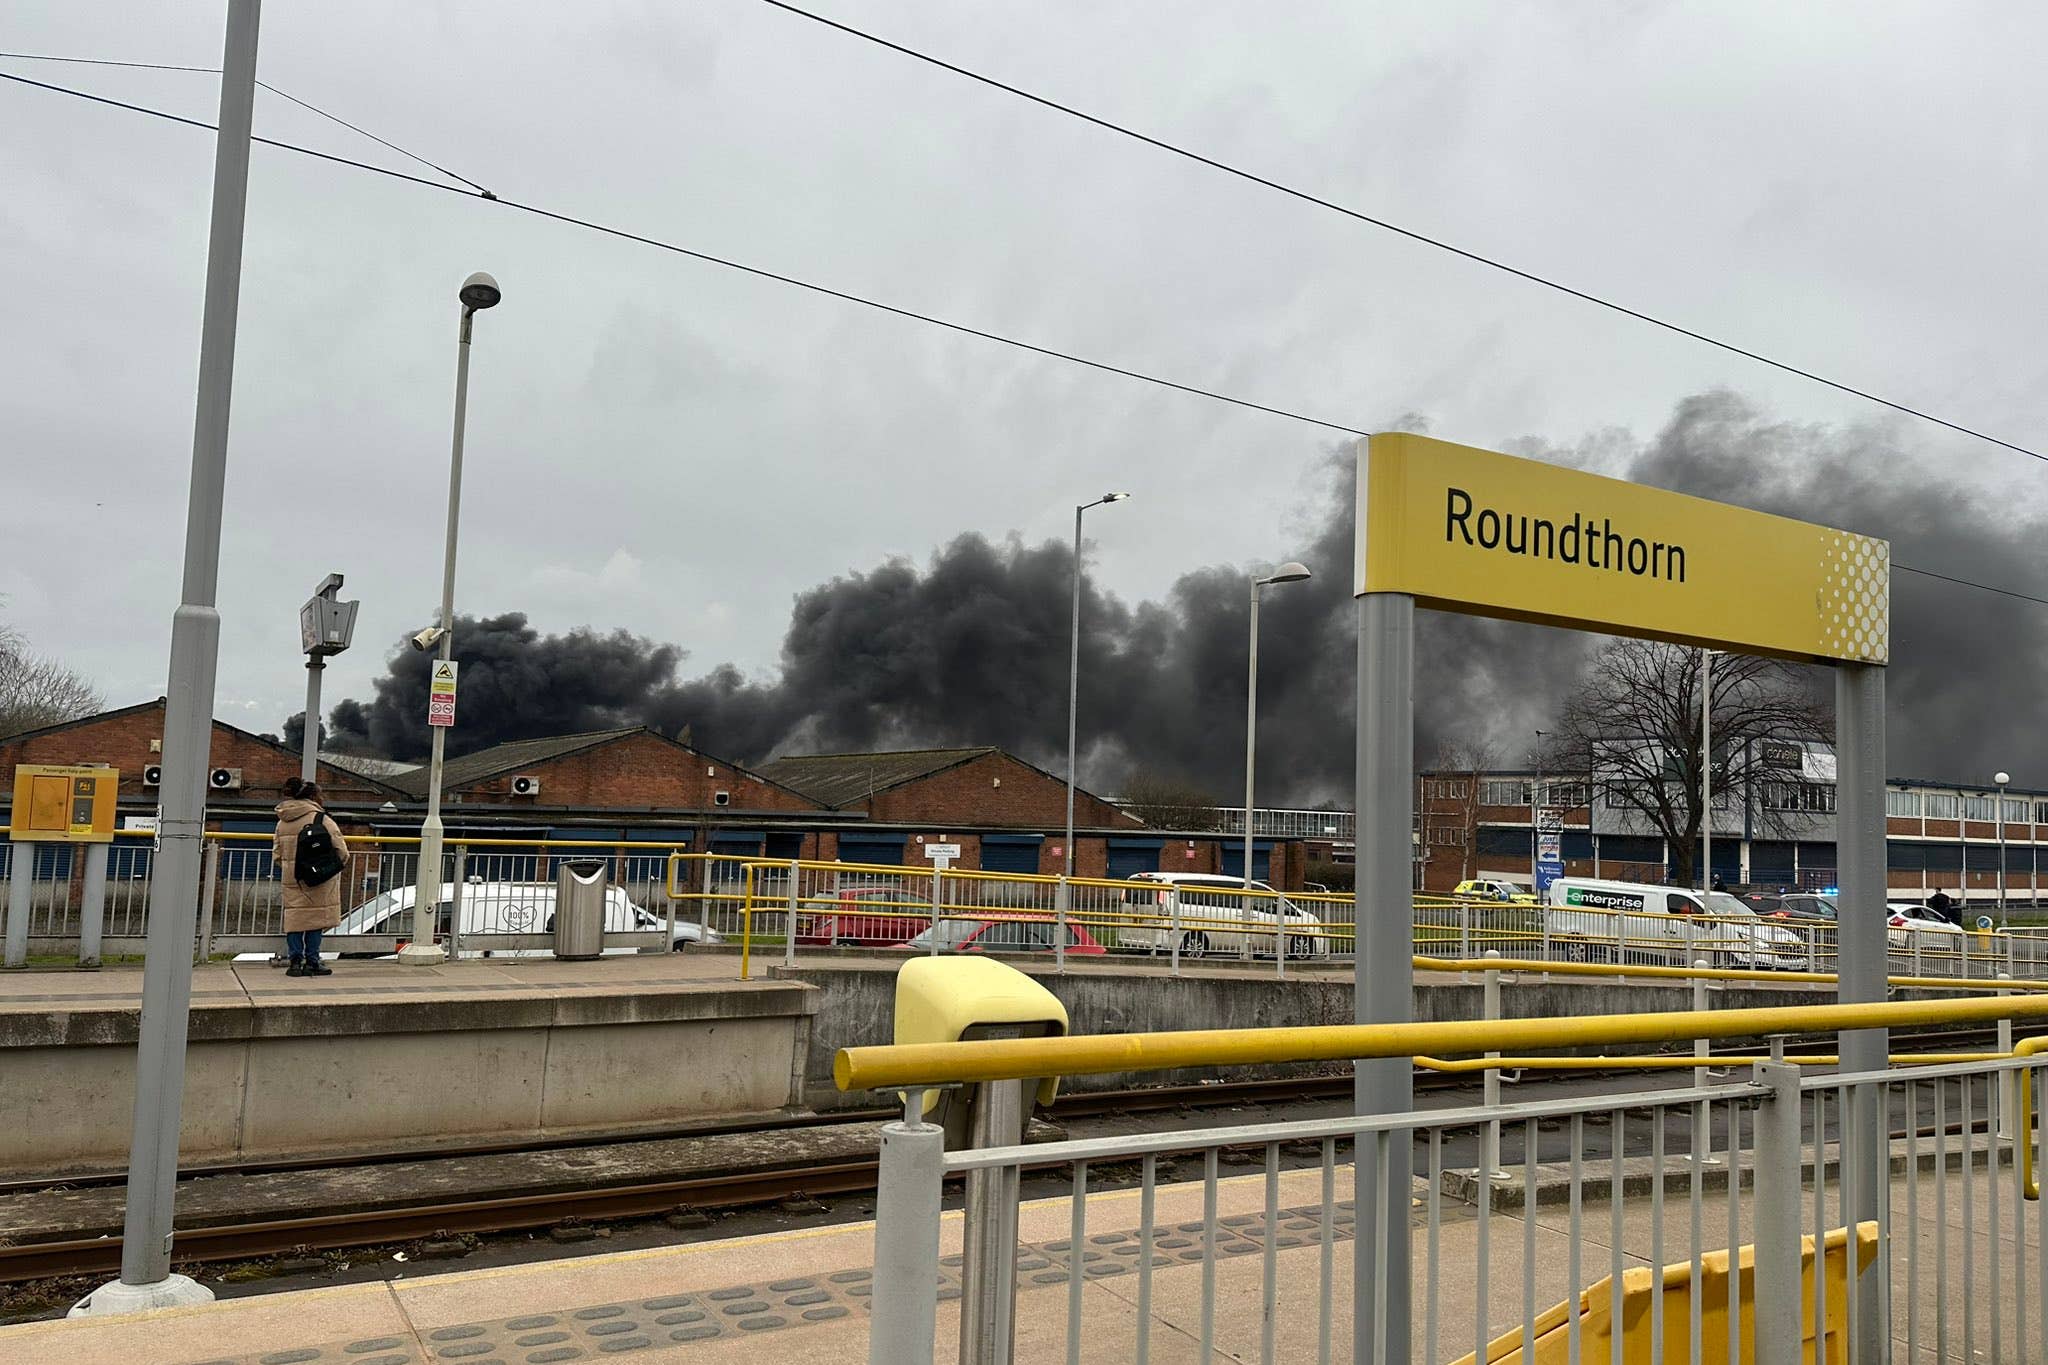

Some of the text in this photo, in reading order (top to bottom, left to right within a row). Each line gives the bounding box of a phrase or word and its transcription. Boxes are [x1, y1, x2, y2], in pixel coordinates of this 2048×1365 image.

[1446, 487, 1685, 583] Roundthorn
[1571, 892, 1643, 908] enterprise
[509, 911, 529, 919] 100%
